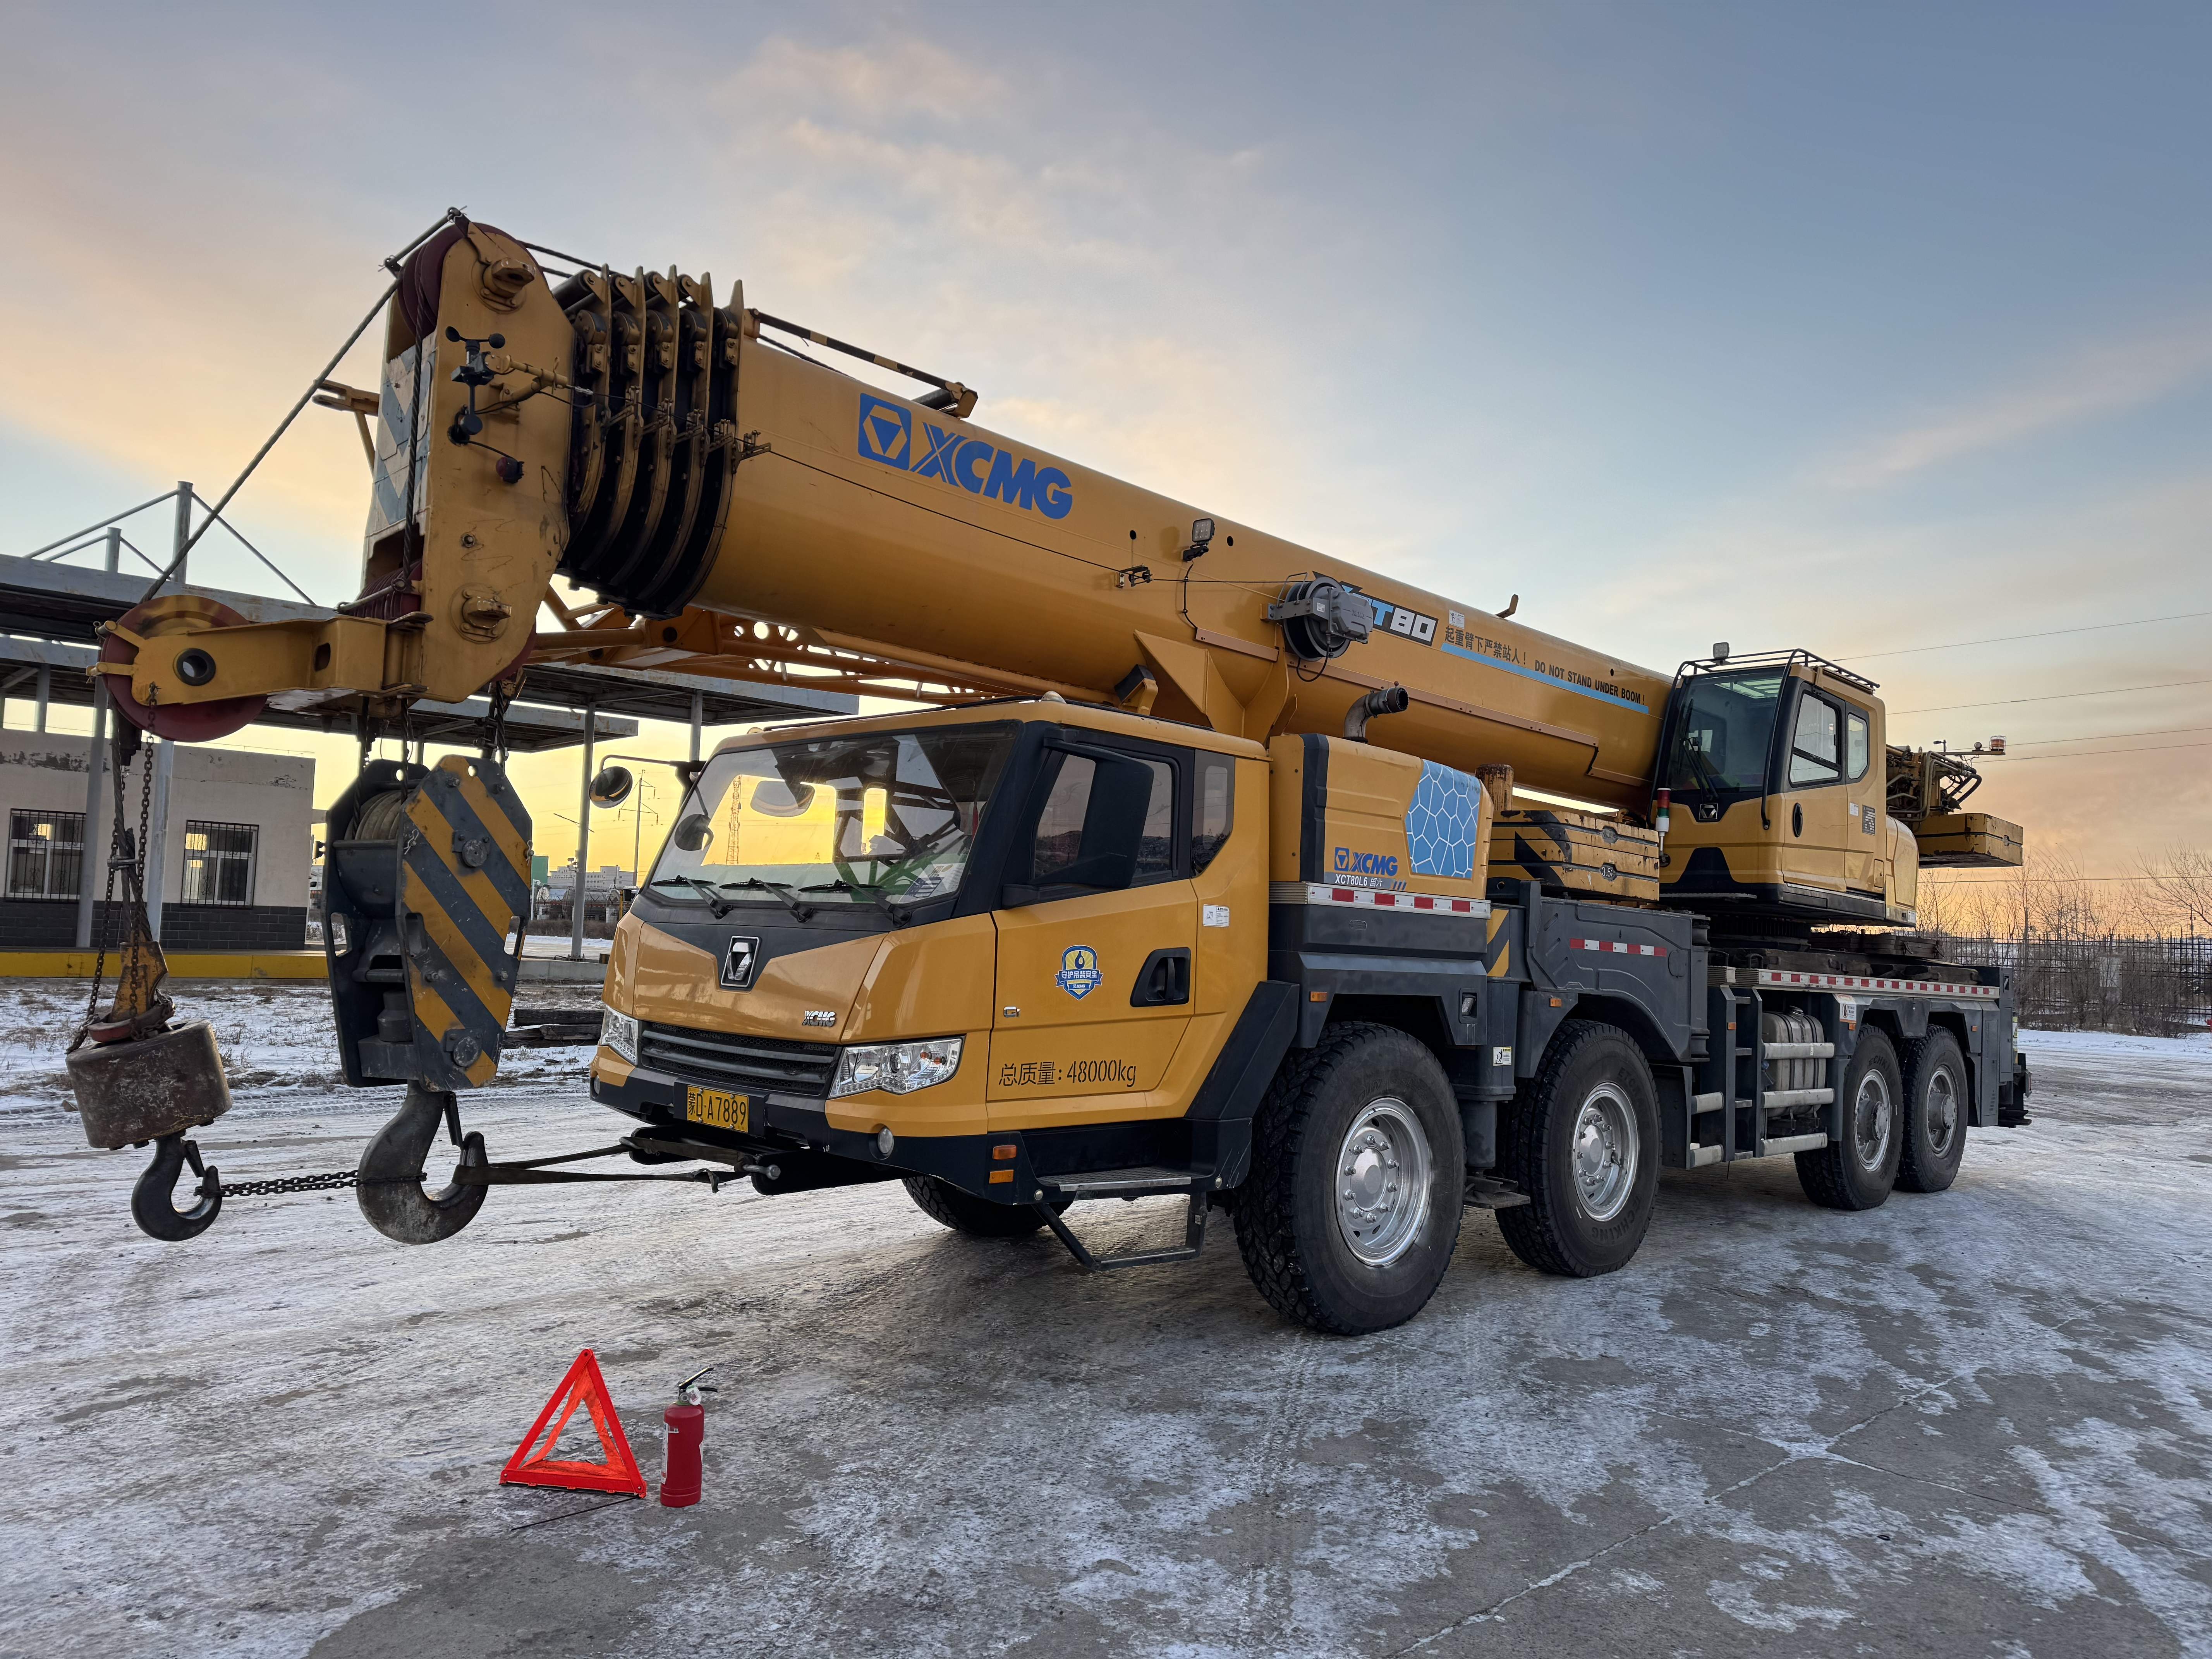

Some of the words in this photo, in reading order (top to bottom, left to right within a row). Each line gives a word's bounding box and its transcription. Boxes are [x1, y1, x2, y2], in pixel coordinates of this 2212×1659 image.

[910, 422, 1073, 520] XCMG
[1444, 625, 1526, 665] 起重臂下严禁站人！
[1535, 659, 1546, 673] DO
[1549, 664, 1565, 680] NOT
[1568, 670, 1592, 688] STAND
[1595, 680, 1618, 697] UNDER
[1349, 852, 1398, 876] XCMG
[1334, 874, 1368, 887] XCT80L6
[1370, 878, 1383, 888] 国六
[1061, 970, 1097, 979] 守护吊装安全
[802, 1010, 836, 1027] XCMG
